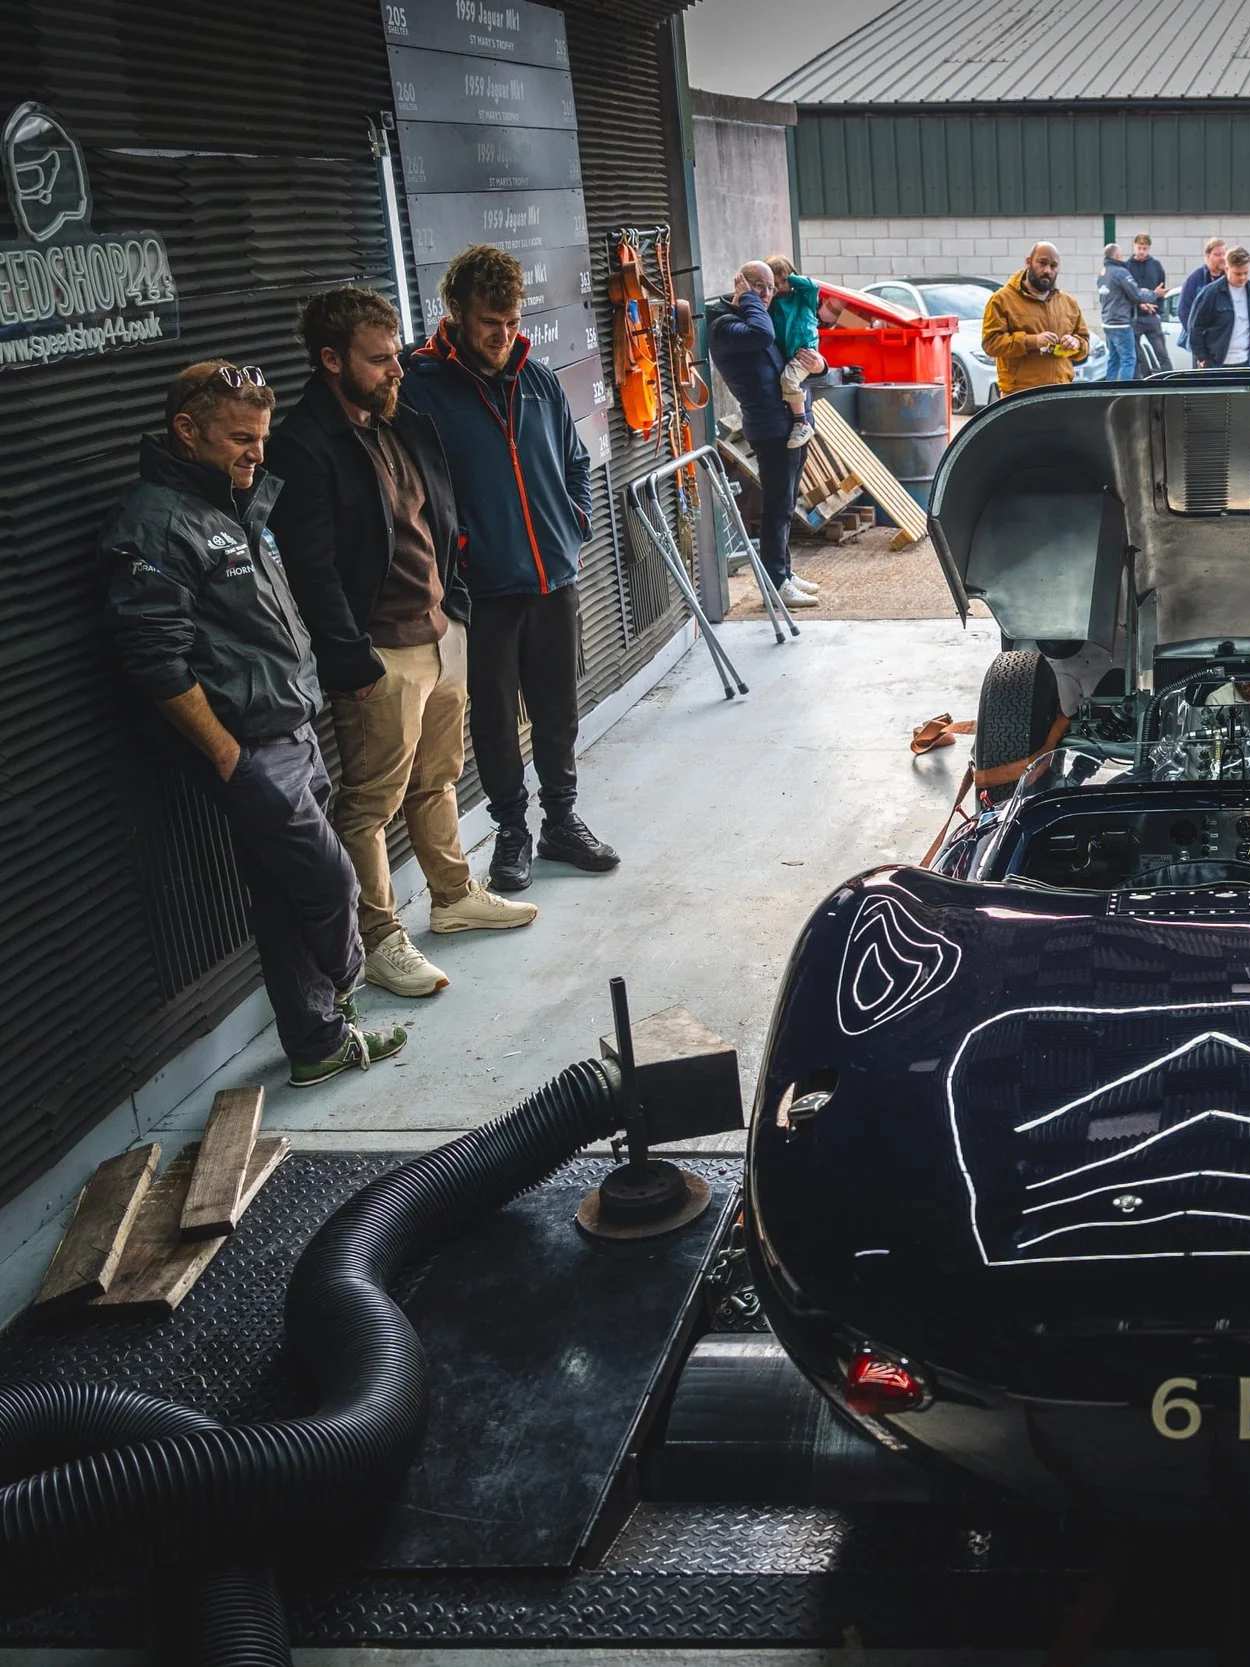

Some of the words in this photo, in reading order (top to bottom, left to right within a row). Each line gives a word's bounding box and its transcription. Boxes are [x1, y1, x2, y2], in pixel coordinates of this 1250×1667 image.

[386, 5, 407, 27] 205
[456, 0, 475, 23] 1959
[478, 2, 504, 31] Jaguar
[396, 81, 416, 102] 260
[465, 74, 484, 97] 1959
[483, 209, 503, 230] 1959
[505, 207, 527, 234] Jaguar
[579, 271, 591, 288] 363
[425, 298, 444, 318] 363
[592, 381, 605, 398] 329
[1152, 1377, 1202, 1440] 6
